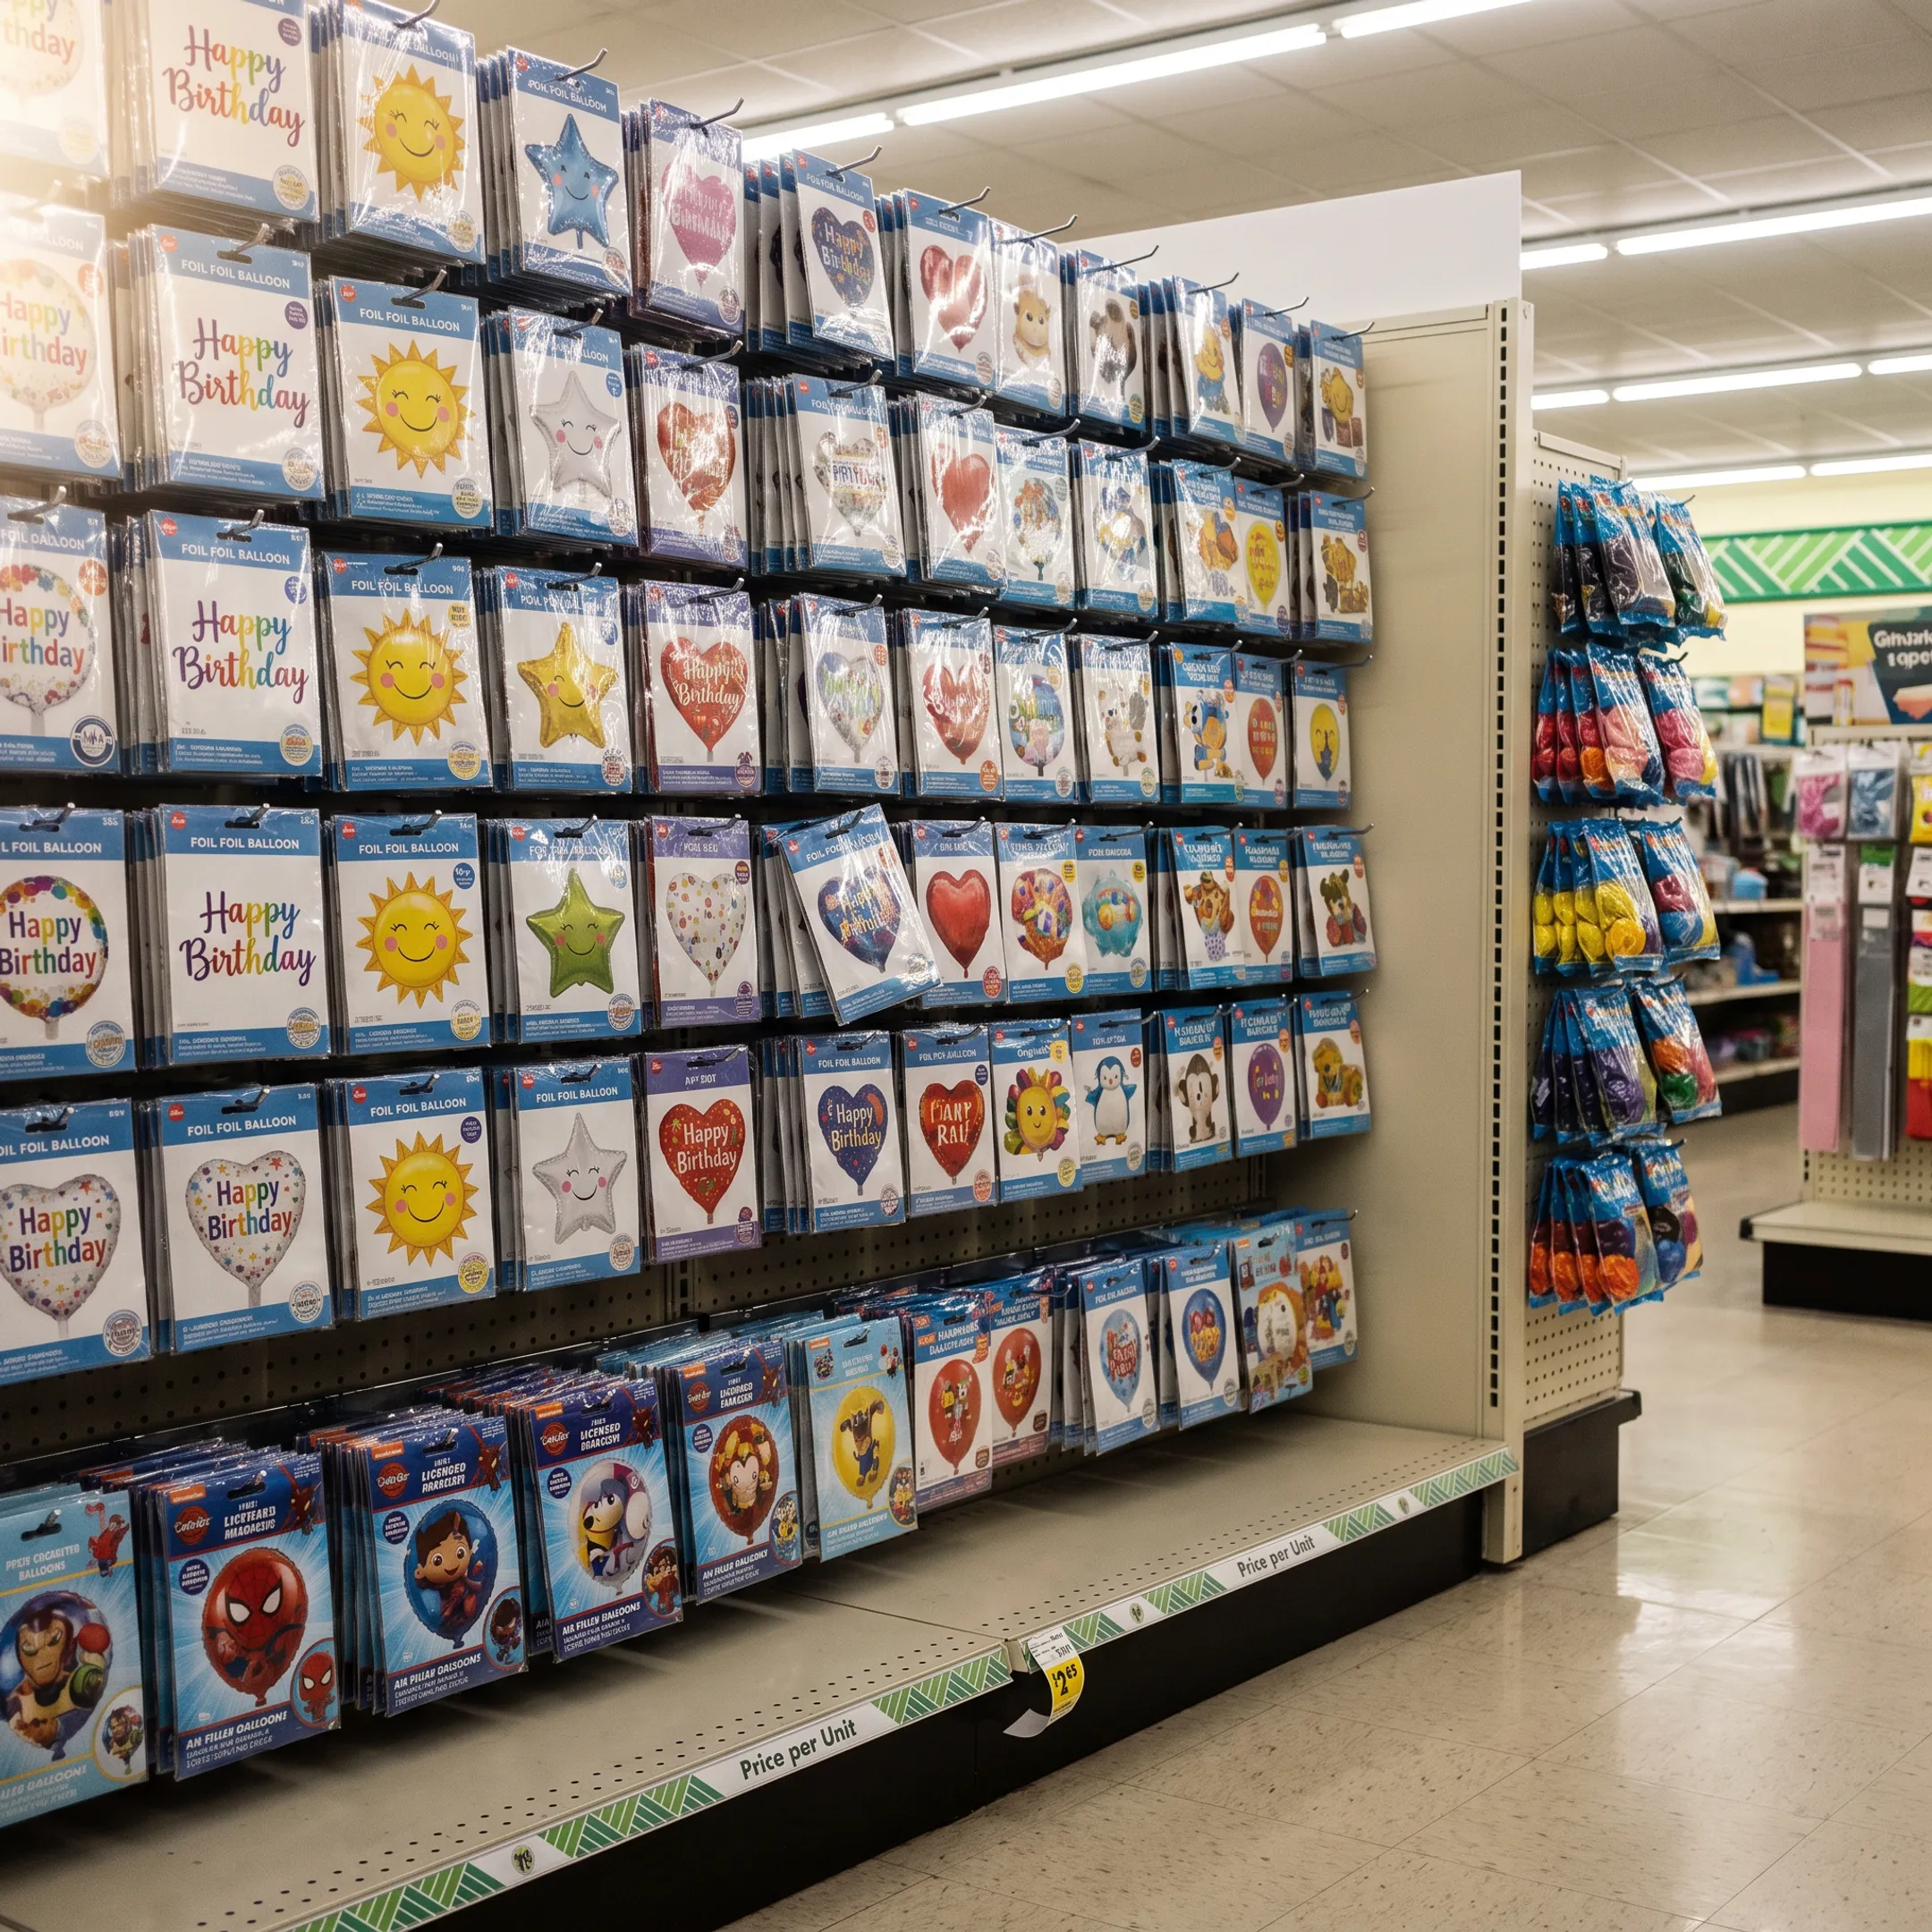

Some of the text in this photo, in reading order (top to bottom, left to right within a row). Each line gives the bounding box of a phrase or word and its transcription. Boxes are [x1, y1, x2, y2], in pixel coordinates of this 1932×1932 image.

[3, 16, 75, 65] thday
[183, 25, 286, 94] Happy
[162, 66, 306, 148] Birthday
[182, 258, 291, 290] FOIL FOIL BALLOON
[360, 308, 461, 333] FOIL FOIL BALLOON
[2, 327, 88, 376] irthday
[192, 317, 293, 378] Happy
[173, 360, 311, 428] Birthday
[182, 543, 208, 556] FOIL
[210, 546, 237, 559] FOIL
[352, 580, 454, 595] FOIL FOIL BALLOON
[191, 599, 292, 656] Happy
[2, 635, 85, 675] irthday
[172, 645, 310, 705] Birthday
[12, 842, 103, 854] FOIL BALLOON
[191, 837, 300, 850] FOIL FOIL BALLOON
[359, 843, 459, 854] FOIL FOIL BALLOON
[8, 911, 81, 945] Happy
[199, 890, 301, 940] Happy
[0, 945, 97, 979] Birthday
[179, 934, 318, 987] Birthday
[370, 1097, 467, 1117] FOIL FOIL BALLOON
[536, 1086, 618, 1103] FOIL FOIL BALLOON
[187, 1115, 297, 1137] FOIL FOIL BALLOON
[836, 1103, 873, 1129] Happy
[0, 1135, 110, 1157] OIL FOIL BALLOON
[683, 1123, 729, 1148] Happy
[831, 1127, 882, 1152] Birthday
[677, 1147, 737, 1174] Birthday
[216, 1180, 280, 1211] Happy
[20, 1207, 91, 1239] Happy
[208, 1209, 292, 1241] Birthday
[9, 1236, 107, 1274] Birthday
[19, 1561, 66, 1581] BALLOONS
[1237, 1535, 1317, 1579] Price per Unit
[739, 1717, 858, 1780] Price per Unit
